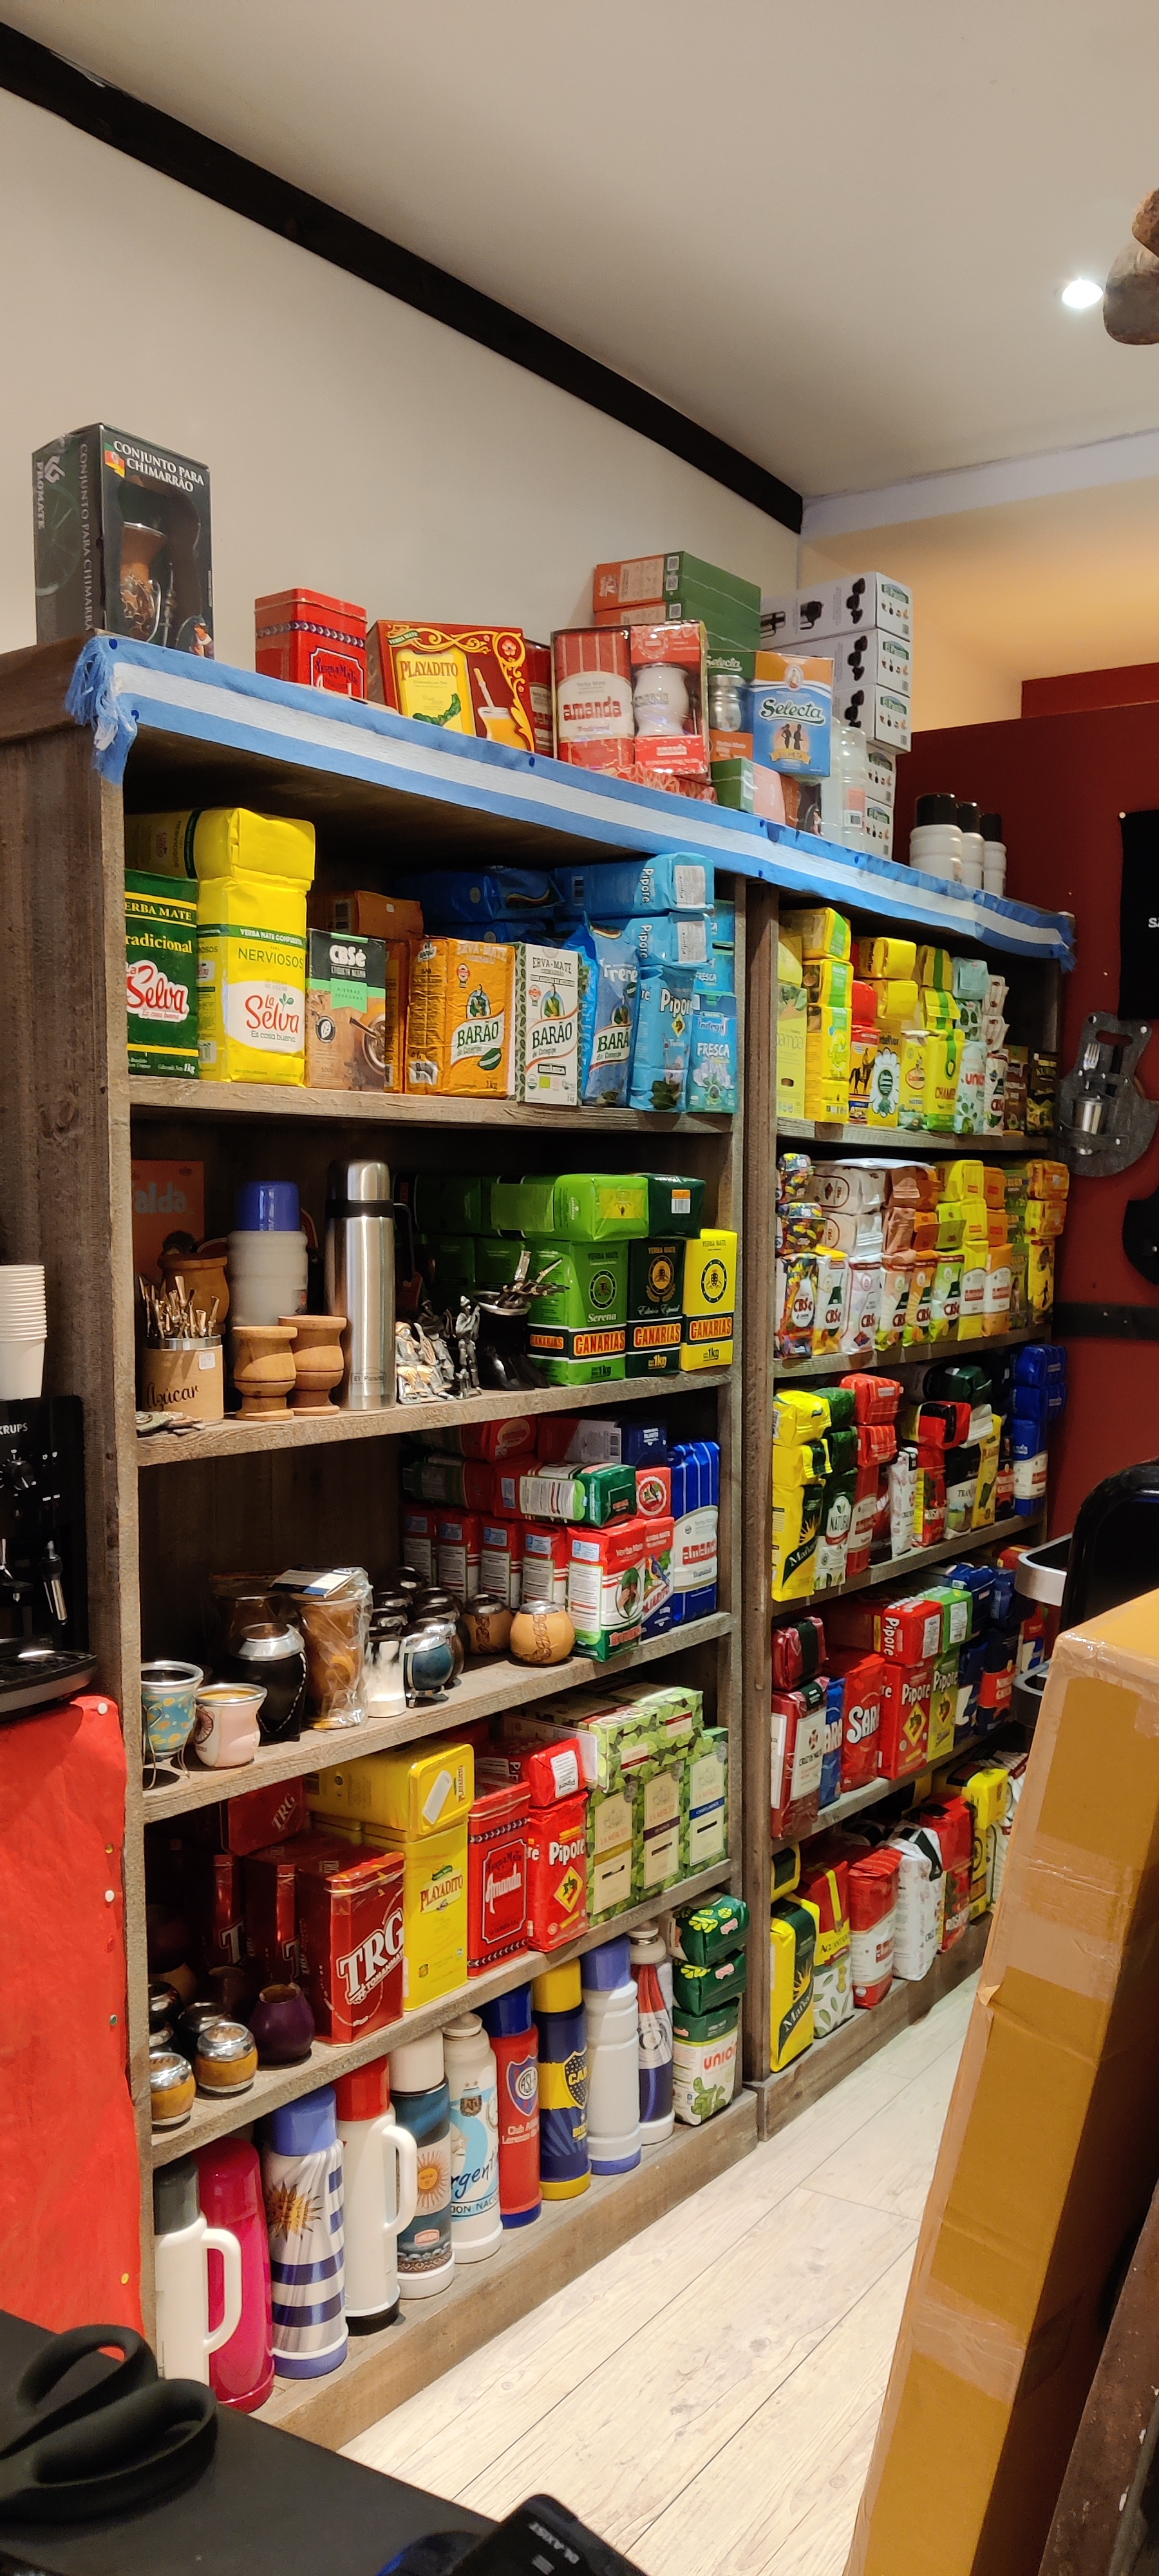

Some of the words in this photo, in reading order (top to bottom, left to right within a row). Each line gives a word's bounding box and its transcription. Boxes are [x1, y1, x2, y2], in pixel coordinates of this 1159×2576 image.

[113, 440, 177, 474] CONJUNTO
[178, 466, 205, 486] PARA
[126, 456, 194, 493] CHIMARRÃO
[79, 442, 90, 521] CONJUNTO
[82, 524, 92, 557] PARA
[399, 660, 459, 681] PLAYADITO
[563, 696, 623, 721] amanda
[760, 699, 823, 720] Selecta
[125, 902, 157, 916] ERBA
[158, 906, 193, 922] MATE
[125, 933, 193, 954] radicional
[239, 928, 261, 938] YERBA
[261, 931, 275, 940] MATE
[238, 947, 304, 970] NERVIOSOS
[329, 944, 367, 968] CBSé
[457, 943, 508, 962] ERVA-MATE
[532, 956, 573, 974] ERVA-MATE
[126, 965, 187, 1014] Selva
[245, 994, 300, 1034] Selva
[265, 994, 275, 1010] La
[260, 1031, 276, 1040] cosa
[276, 1032, 297, 1043] buena
[457, 1019, 500, 1049] BARÃO
[532, 1021, 573, 1050] BARÃO
[597, 1028, 630, 1053] BARÃ
[696, 1042, 730, 1059] FRESCA
[134, 1181, 188, 1215] alda
[587, 1312, 617, 1323] Serena
[690, 1316, 733, 1341] CANARIAS
[531, 1334, 564, 1350] CANARIAS
[574, 1330, 626, 1357] CANARIAS
[634, 1322, 682, 1349] CANARIAS
[653, 1354, 668, 1368] 1kg
[708, 1347, 720, 1361] 1kg
[0, 1422, 28, 1435] KRUPS
[270, 1794, 298, 1830] TRG
[420, 1874, 464, 1913] PLAYADITO
[339, 1908, 404, 1997] TRG
